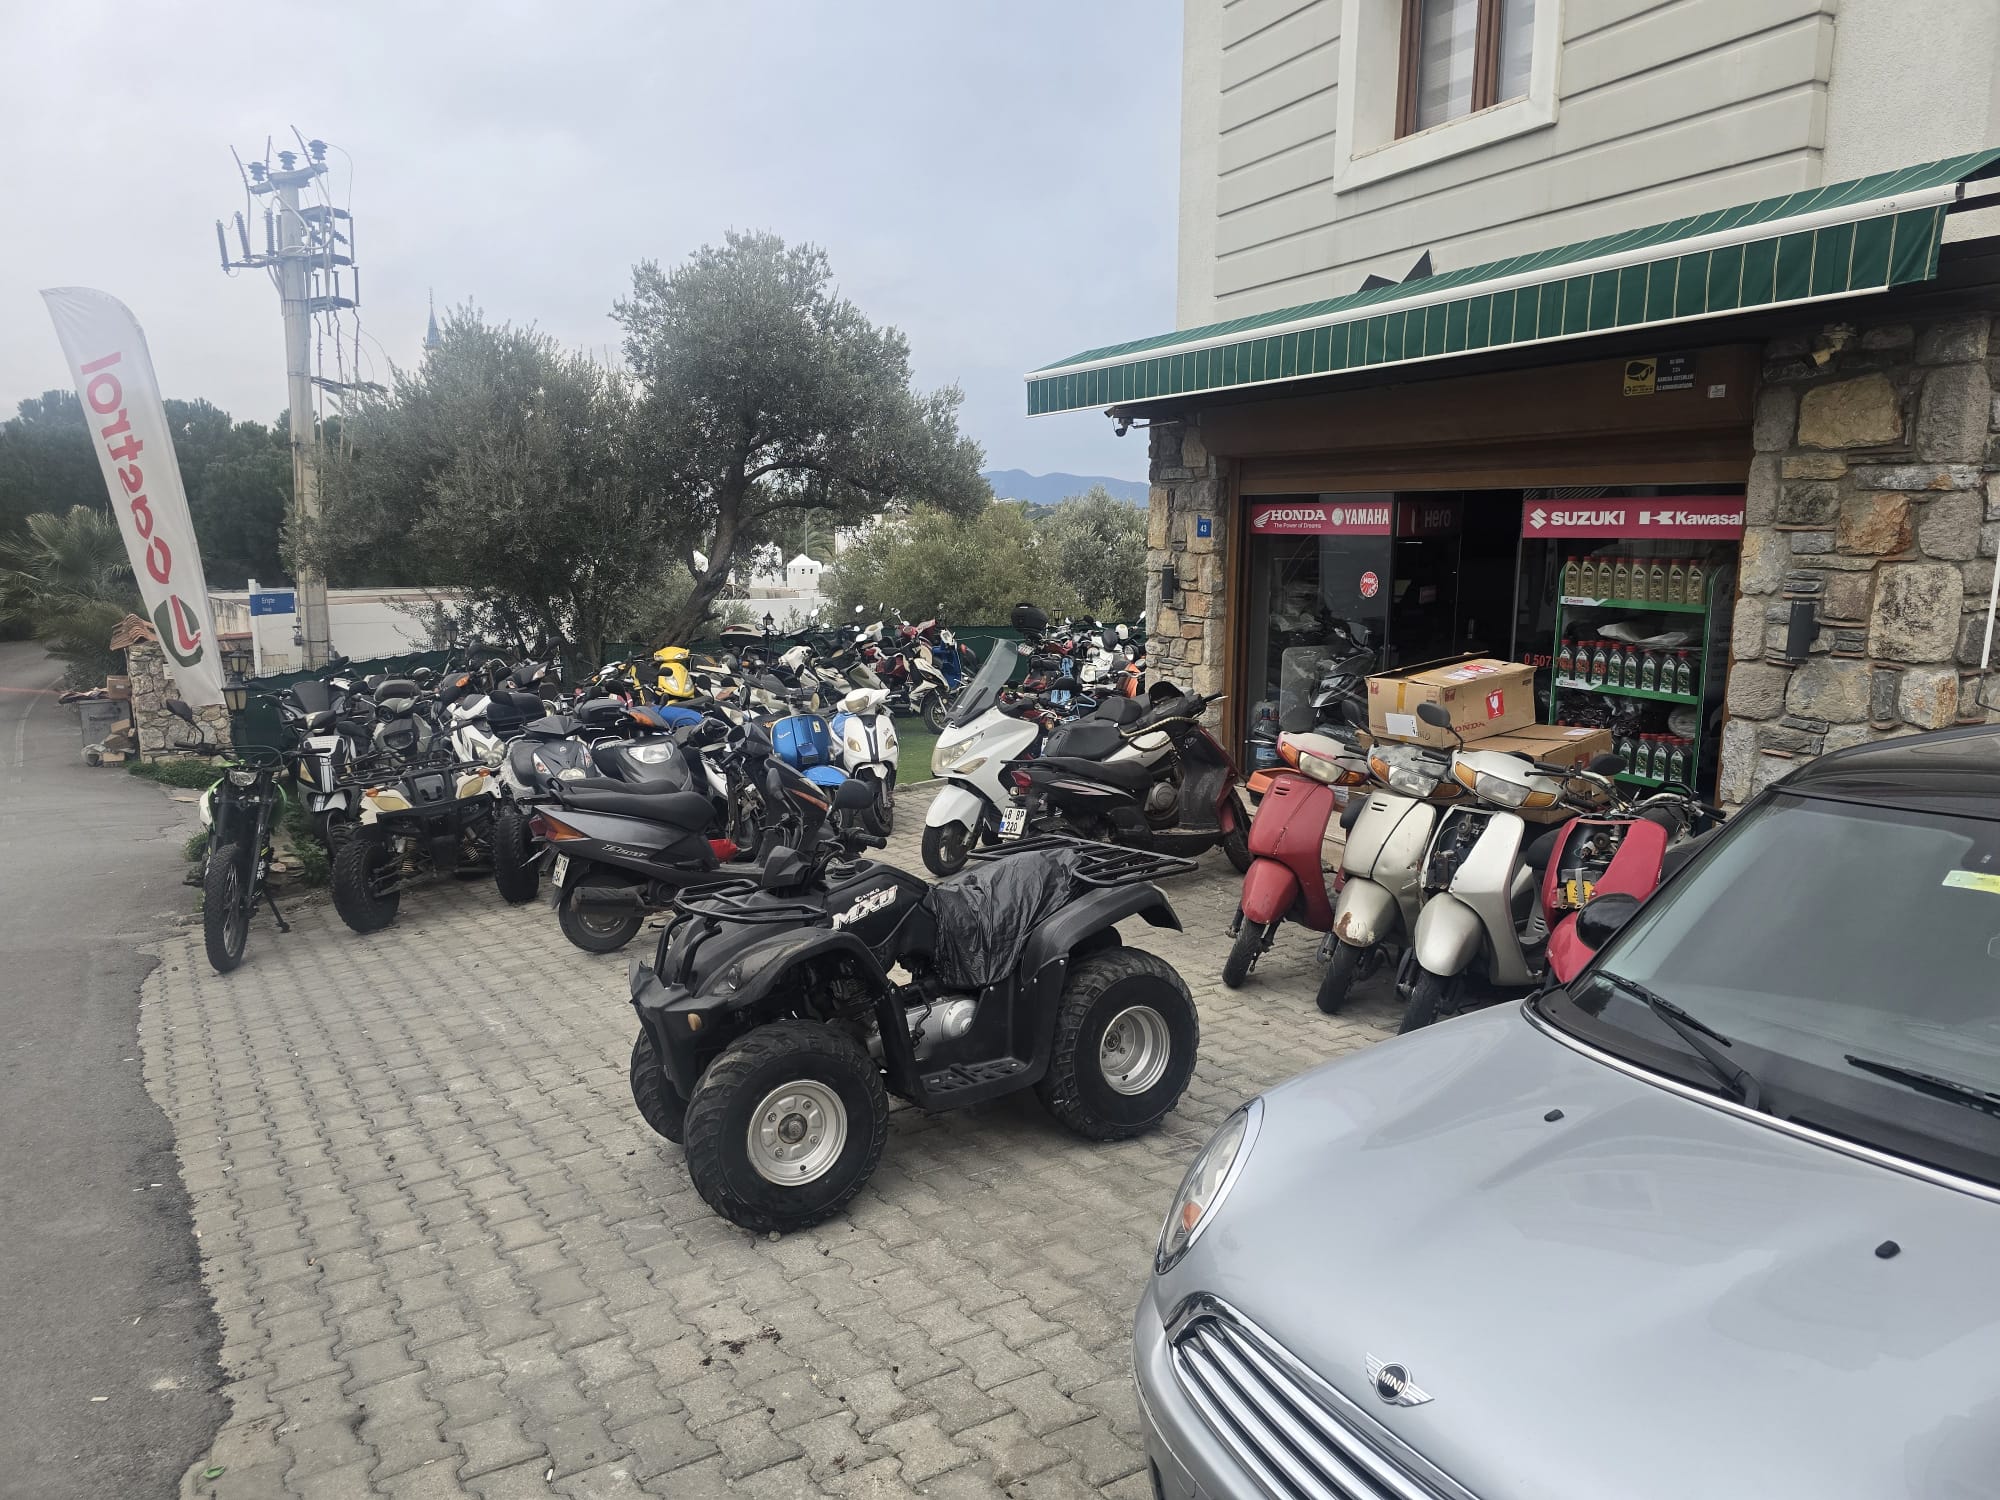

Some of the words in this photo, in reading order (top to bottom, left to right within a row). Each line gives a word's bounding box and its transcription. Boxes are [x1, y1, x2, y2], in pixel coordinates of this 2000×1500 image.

[1270, 509, 1327, 521] HONDA
[1344, 508, 1389, 525] YAMAHA
[1424, 509, 1452, 529] Hero
[1550, 510, 1626, 526] SUZUKI
[1524, 653, 1530, 665] 0
[1533, 655, 1552, 667] 507
[830, 885, 898, 930] MXU
[1379, 1370, 1405, 1393] MINI
